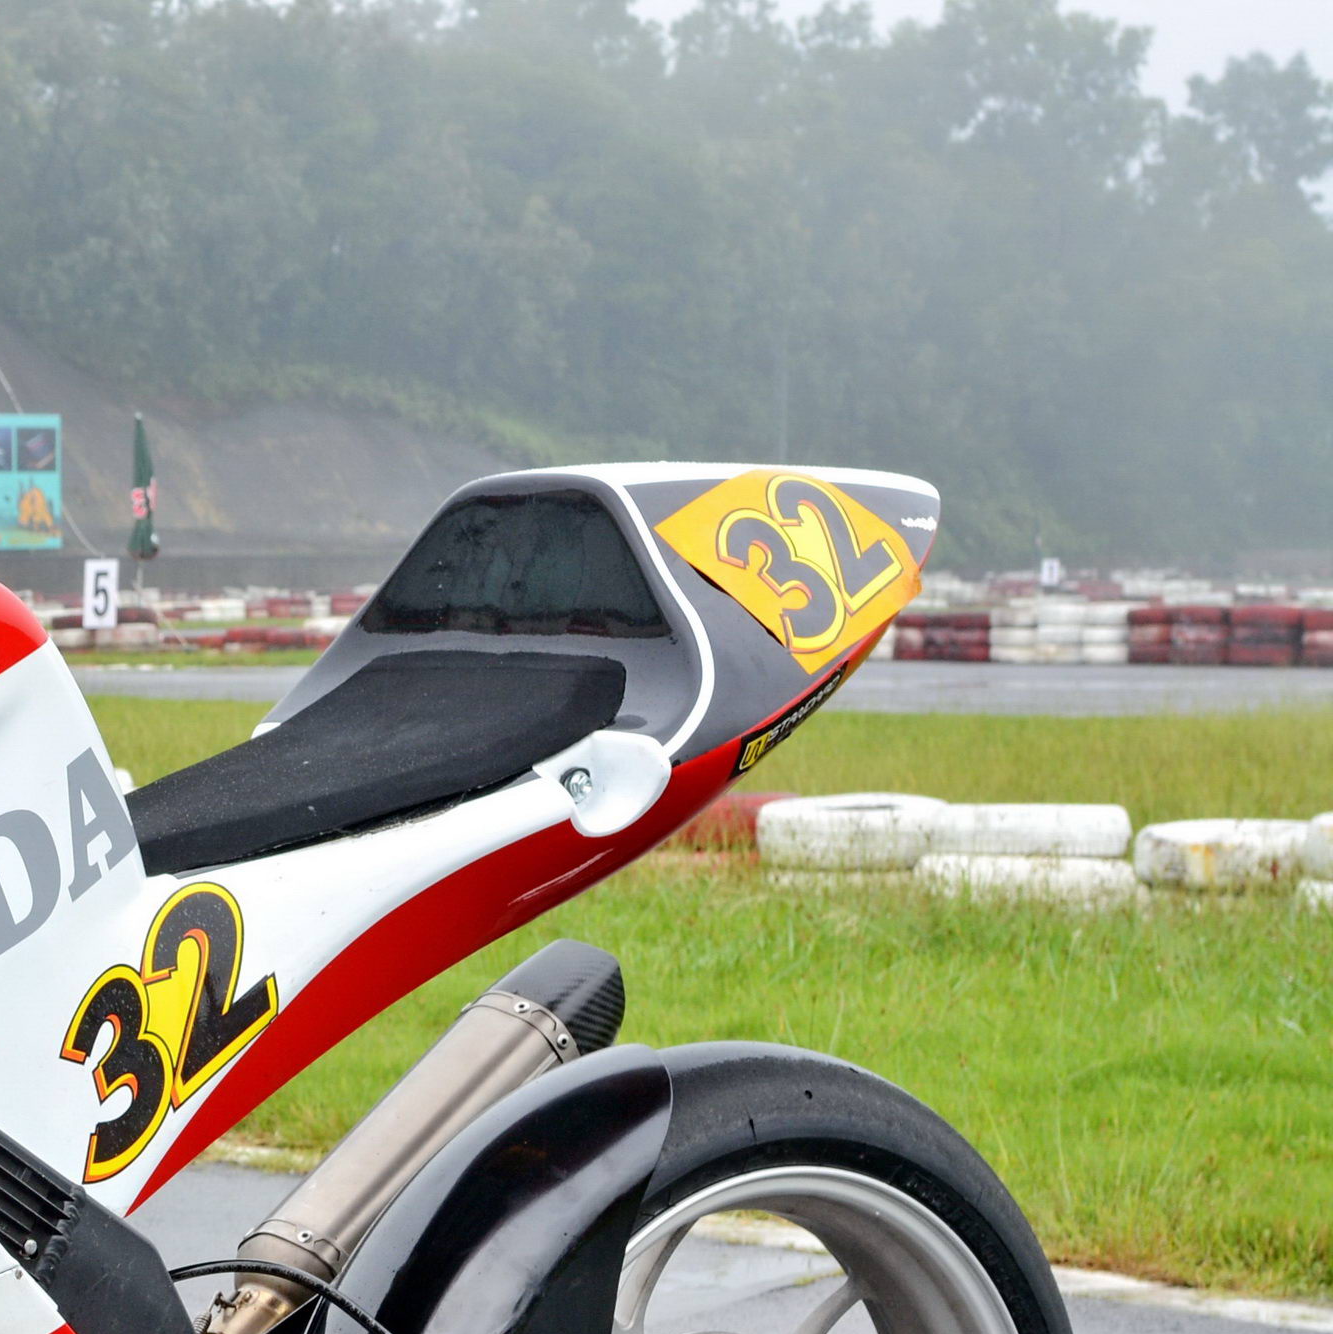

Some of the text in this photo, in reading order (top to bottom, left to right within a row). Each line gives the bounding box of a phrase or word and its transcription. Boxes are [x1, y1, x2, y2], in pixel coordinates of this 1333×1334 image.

[93, 571, 109, 617] 5
[716, 474, 904, 654] 32
[59, 881, 280, 1183] 32
